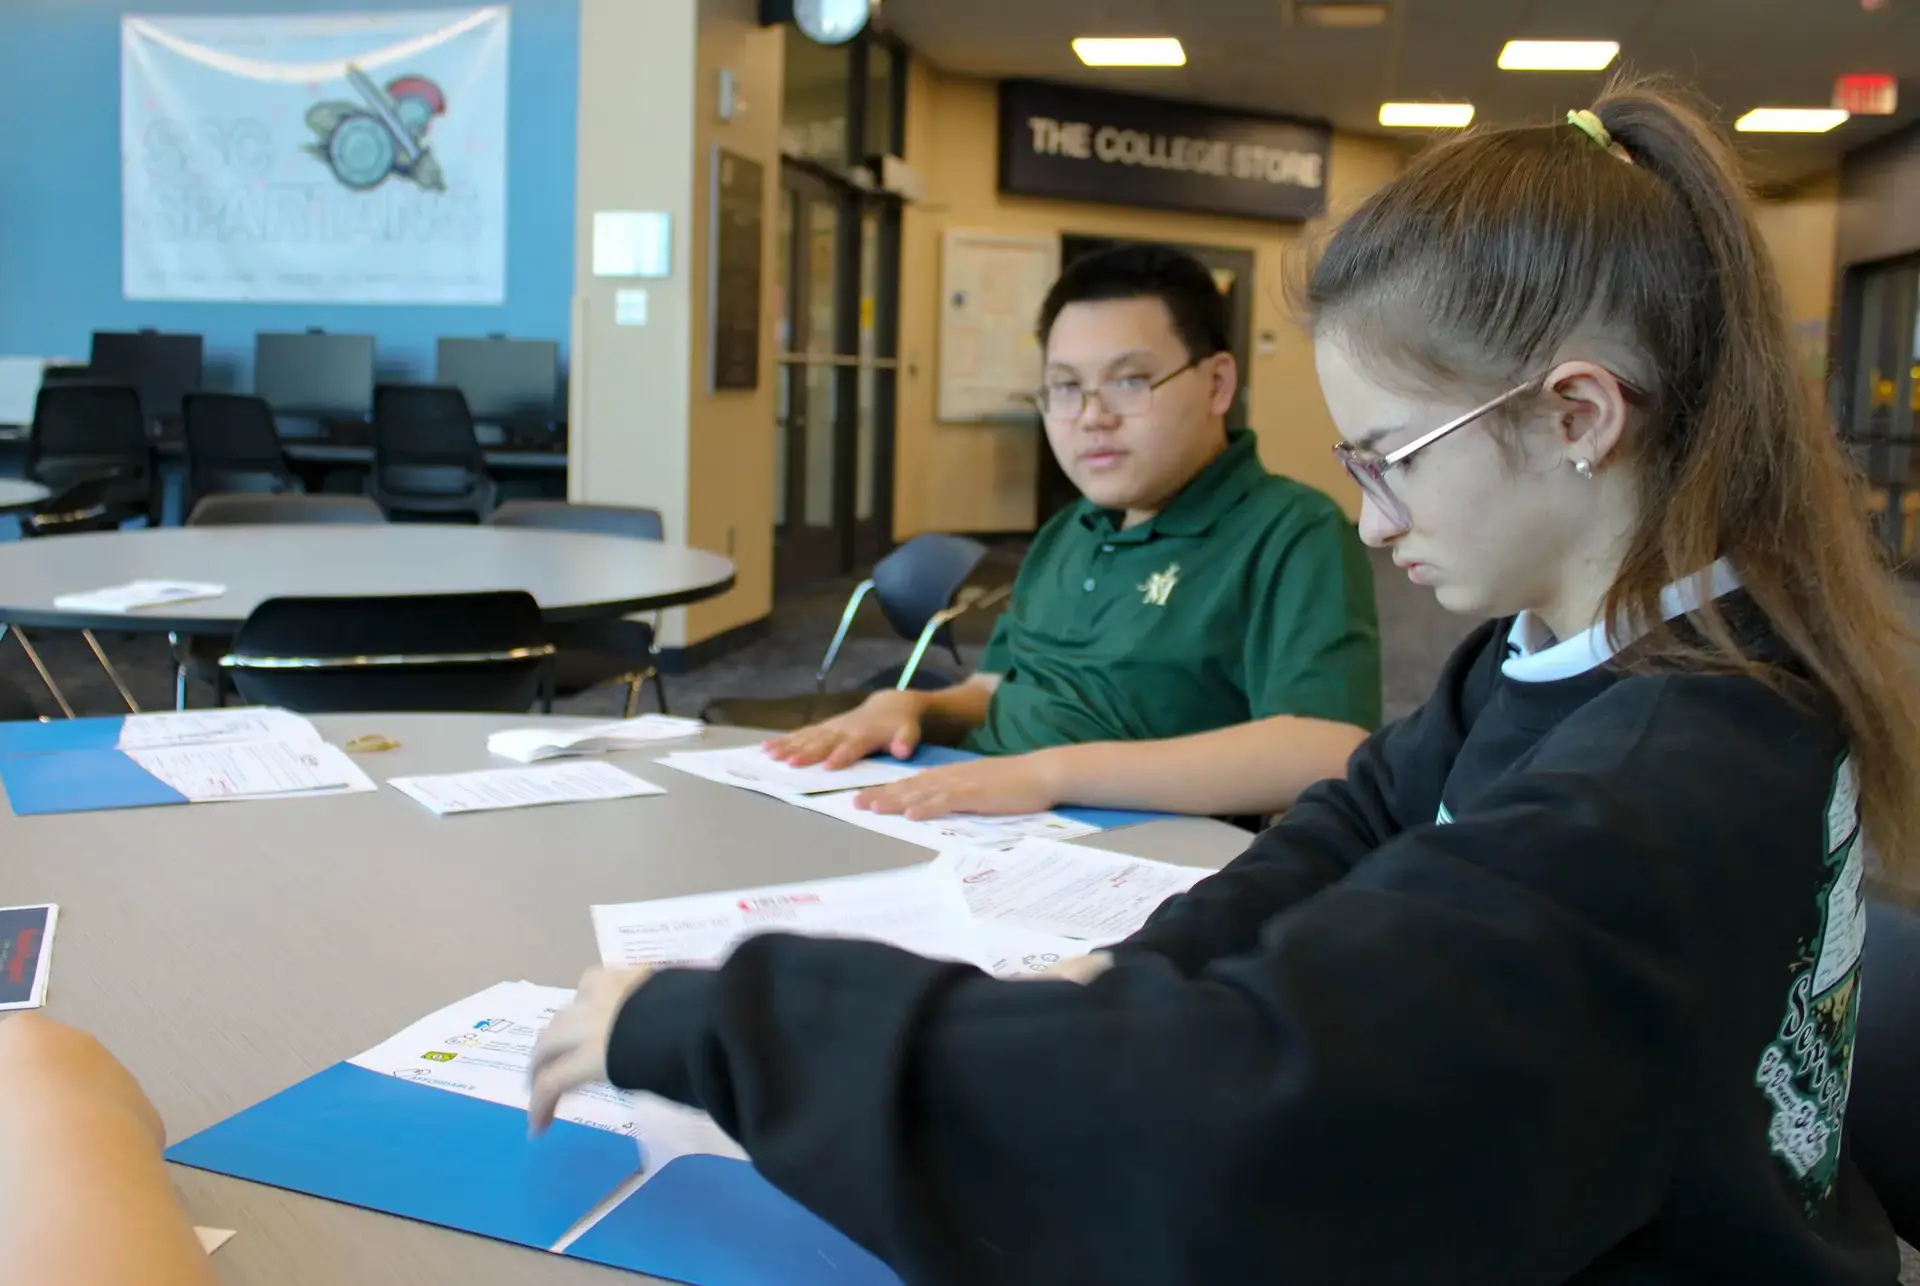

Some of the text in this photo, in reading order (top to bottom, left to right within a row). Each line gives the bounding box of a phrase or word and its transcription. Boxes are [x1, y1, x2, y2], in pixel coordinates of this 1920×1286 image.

[1028, 116, 1323, 189] THE COLLEGE STORE
